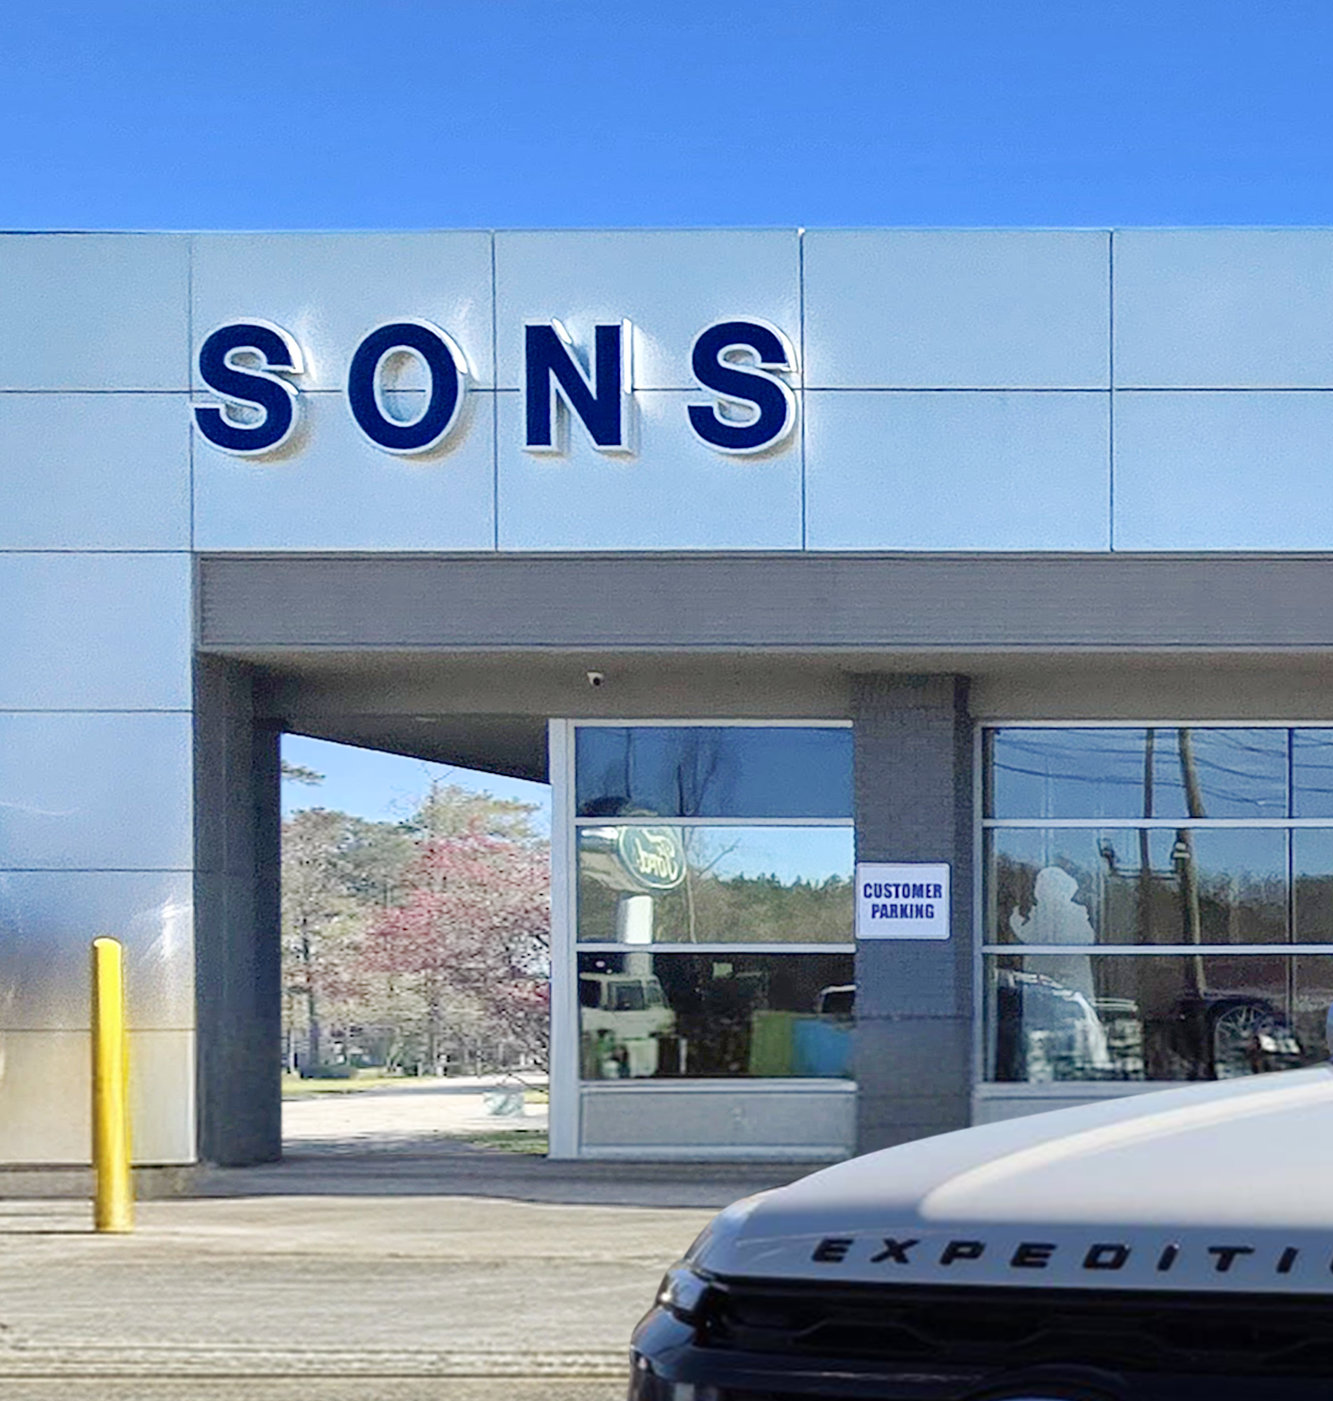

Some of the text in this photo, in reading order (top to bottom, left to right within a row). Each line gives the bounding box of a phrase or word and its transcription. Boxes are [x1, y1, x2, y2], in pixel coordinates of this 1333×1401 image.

[193, 321, 790, 453] SONS
[862, 882, 943, 899] CUSTOMER
[871, 903, 935, 919] PARKING
